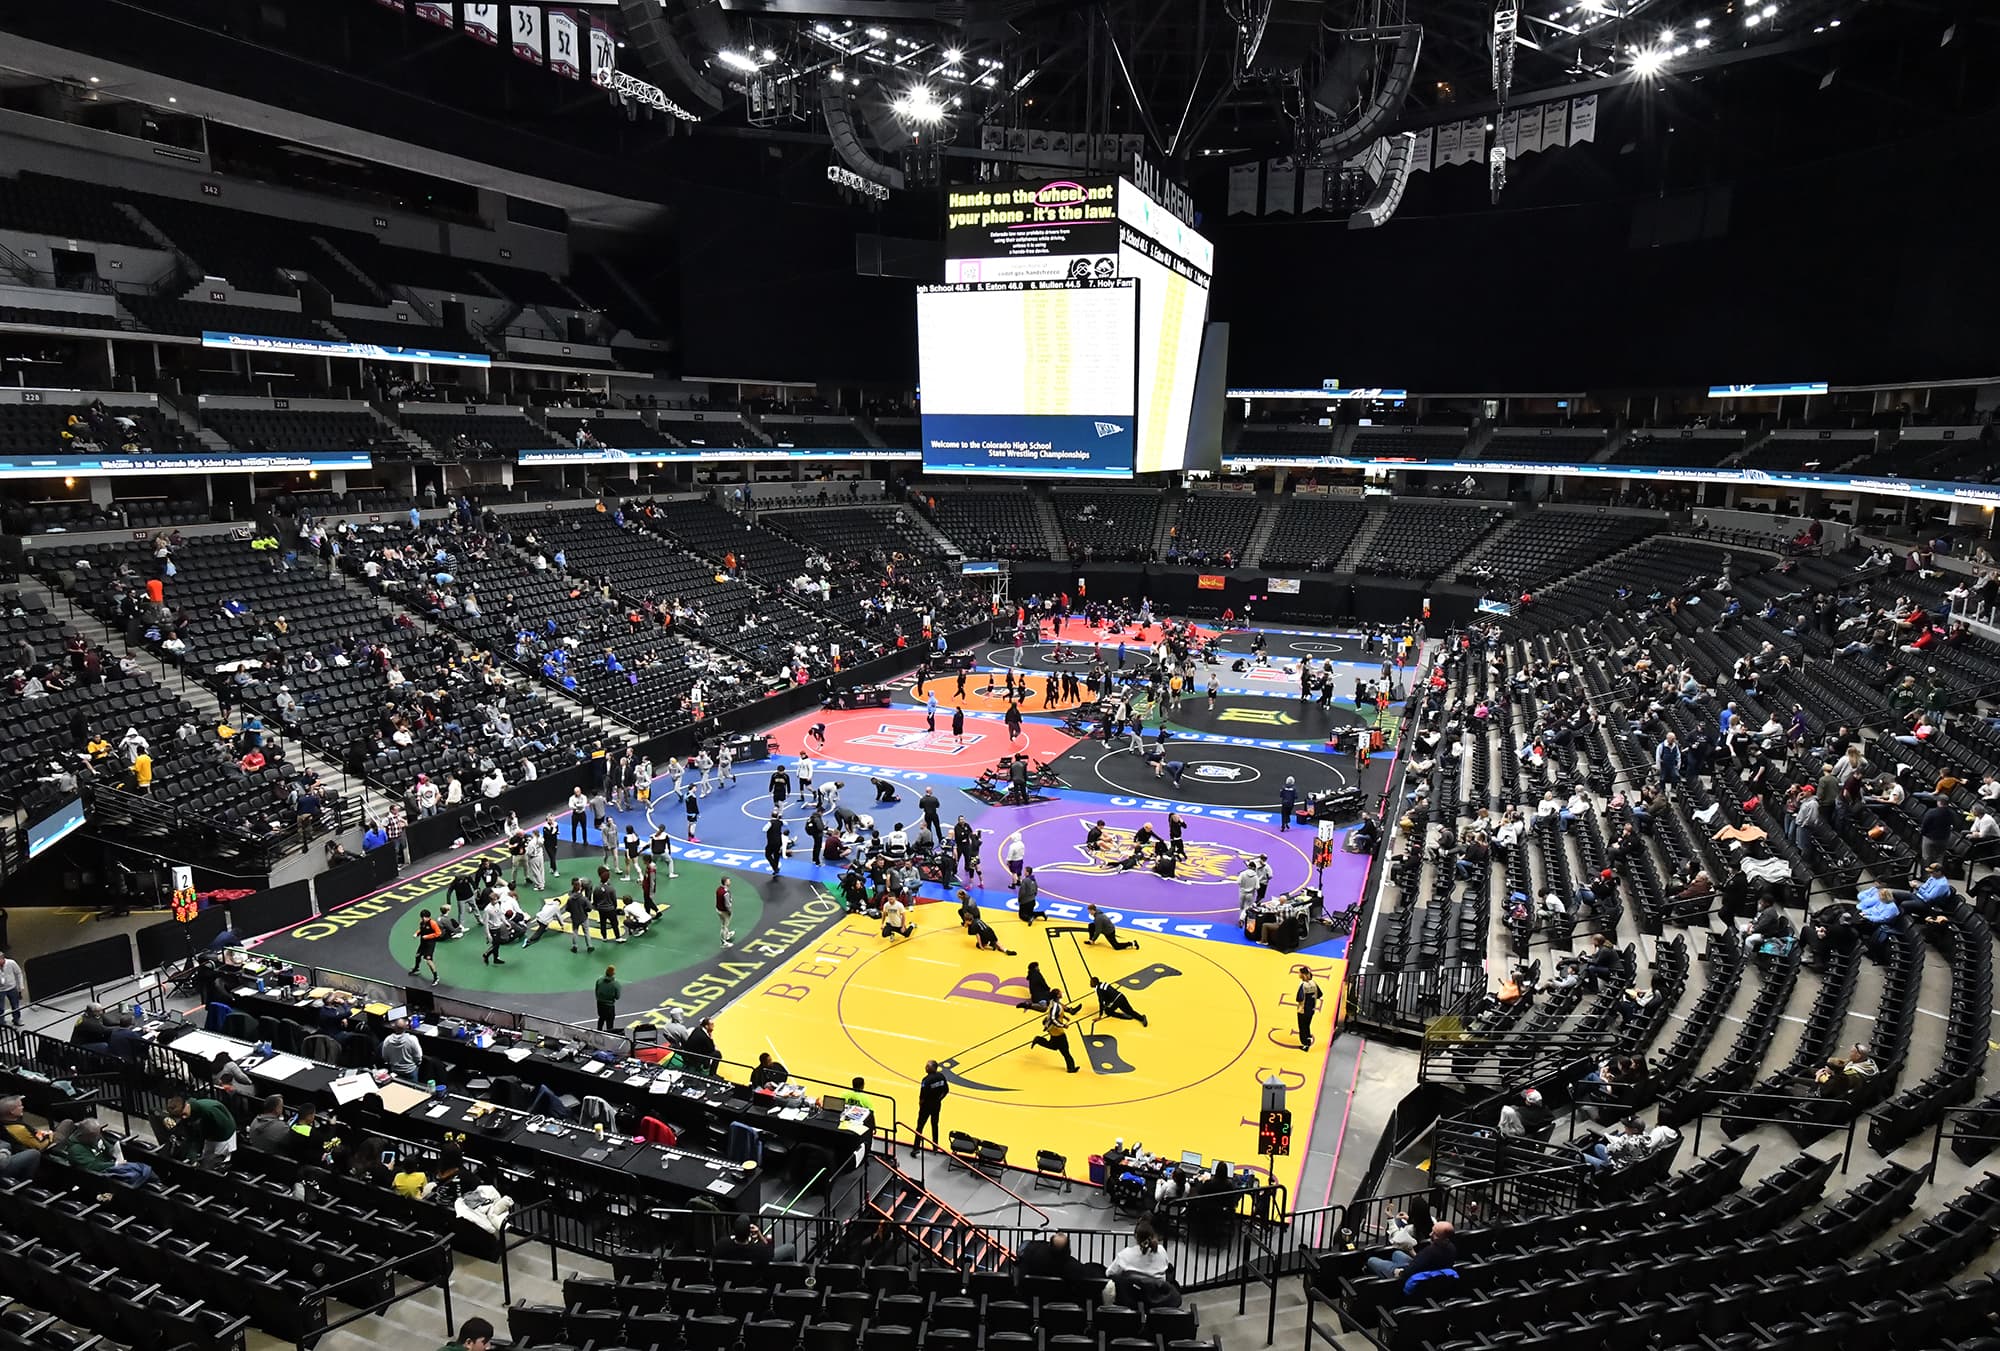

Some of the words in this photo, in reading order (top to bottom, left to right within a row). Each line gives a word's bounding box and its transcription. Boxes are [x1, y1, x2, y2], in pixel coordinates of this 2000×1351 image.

[559, 30, 571, 56] 52
[204, 185, 219, 195] 342
[1134, 152, 1161, 205] BALL
[1163, 178, 1195, 229] ARENA
[949, 192, 991, 208] Hands
[994, 193, 1010, 205] on
[1012, 190, 1035, 204] the
[1088, 185, 1113, 200] not
[949, 213, 980, 229] your
[982, 210, 1024, 227] phone
[1058, 205, 1083, 220] the
[1084, 204, 1116, 219] law.
[929, 284, 954, 292] School
[985, 283, 1006, 291] Eaton
[1088, 280, 1096, 288] 7.
[1097, 279, 1115, 289] Holy
[212, 292, 224, 301] 341
[258, 339, 272, 348] High
[293, 342, 317, 350] Activities
[931, 440, 960, 449] Welcome
[961, 441, 968, 449] to
[969, 441, 981, 449] the
[982, 441, 1012, 450] Colorado
[1013, 442, 1028, 451] High
[1029, 442, 1052, 450] School
[988, 449, 1006, 457] State
[1006, 449, 1038, 459] Wrestling
[1039, 450, 1090, 460] Championships
[101, 460, 134, 469] Welcome
[135, 461, 143, 469] to
[143, 461, 156, 469] the
[156, 460, 187, 468] Colorado
[187, 459, 201, 469] High
[203, 459, 225, 467] School
[225, 458, 241, 467] State
[242, 458, 270, 468] Wrestling
[1177, 733, 1311, 752] CHSAA
[1110, 798, 1273, 823] CHSAA
[181, 874, 189, 888] 2
[742, 893, 842, 958] ONTE
[761, 924, 880, 1003] BEET
[1268, 1112, 1283, 1124] 27
[1282, 1123, 1290, 1134] 2
[1281, 1135, 1289, 1146] 0
[1266, 1144, 1274, 1155] 2
